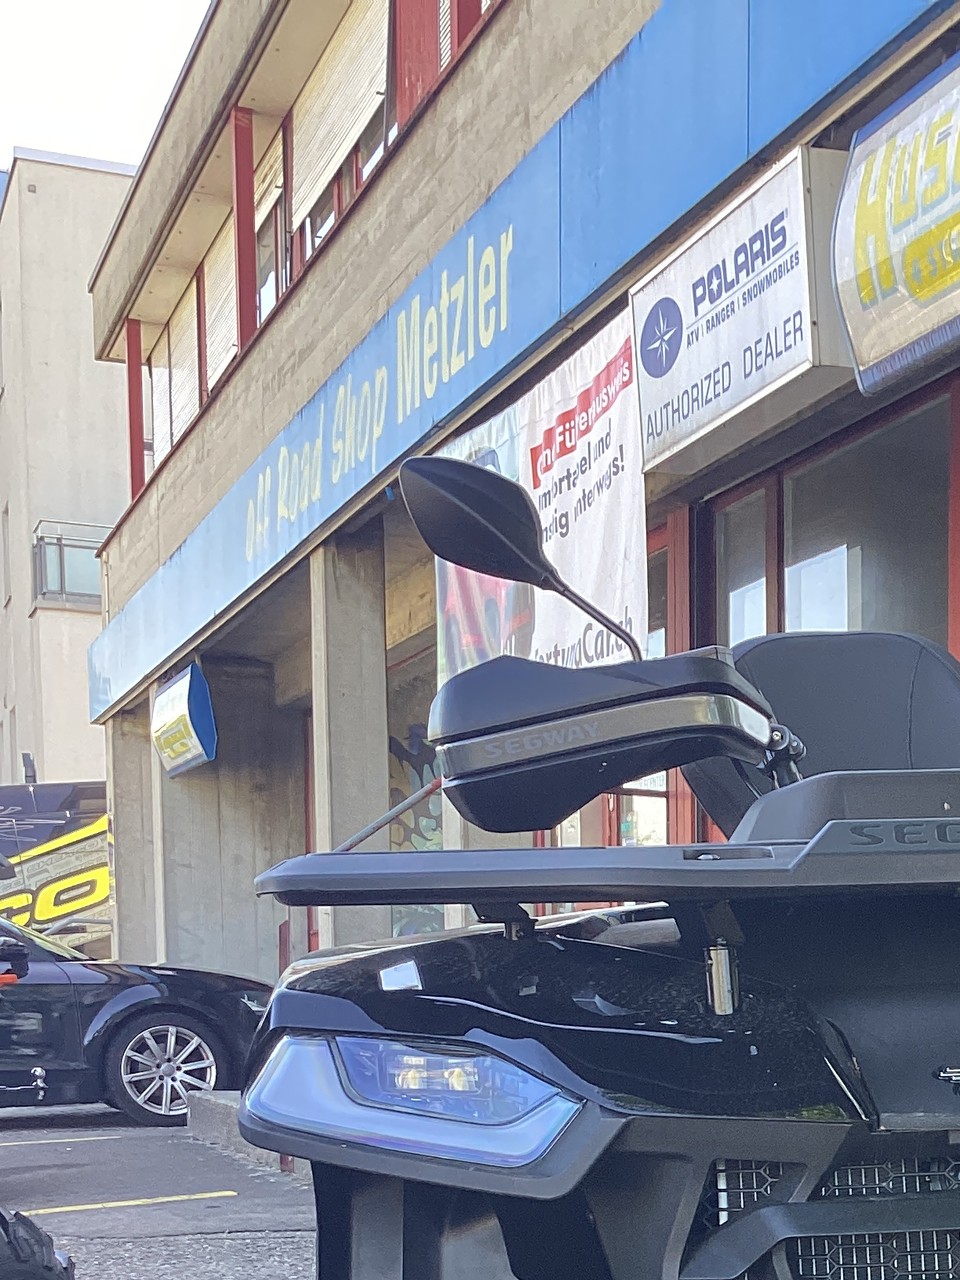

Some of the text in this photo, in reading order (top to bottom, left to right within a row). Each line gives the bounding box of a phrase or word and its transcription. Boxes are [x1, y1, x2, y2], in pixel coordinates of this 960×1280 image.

[686, 250, 800, 350] ATV RANGER SNOWMOBILES
[692, 210, 788, 317] POLARIS
[277, 404, 324, 533] Road
[331, 365, 388, 485] Shop
[397, 223, 513, 425] Metzler
[646, 309, 804, 444] AUTHORIZED DEALER
[485, 722, 600, 758] SEGWAY
